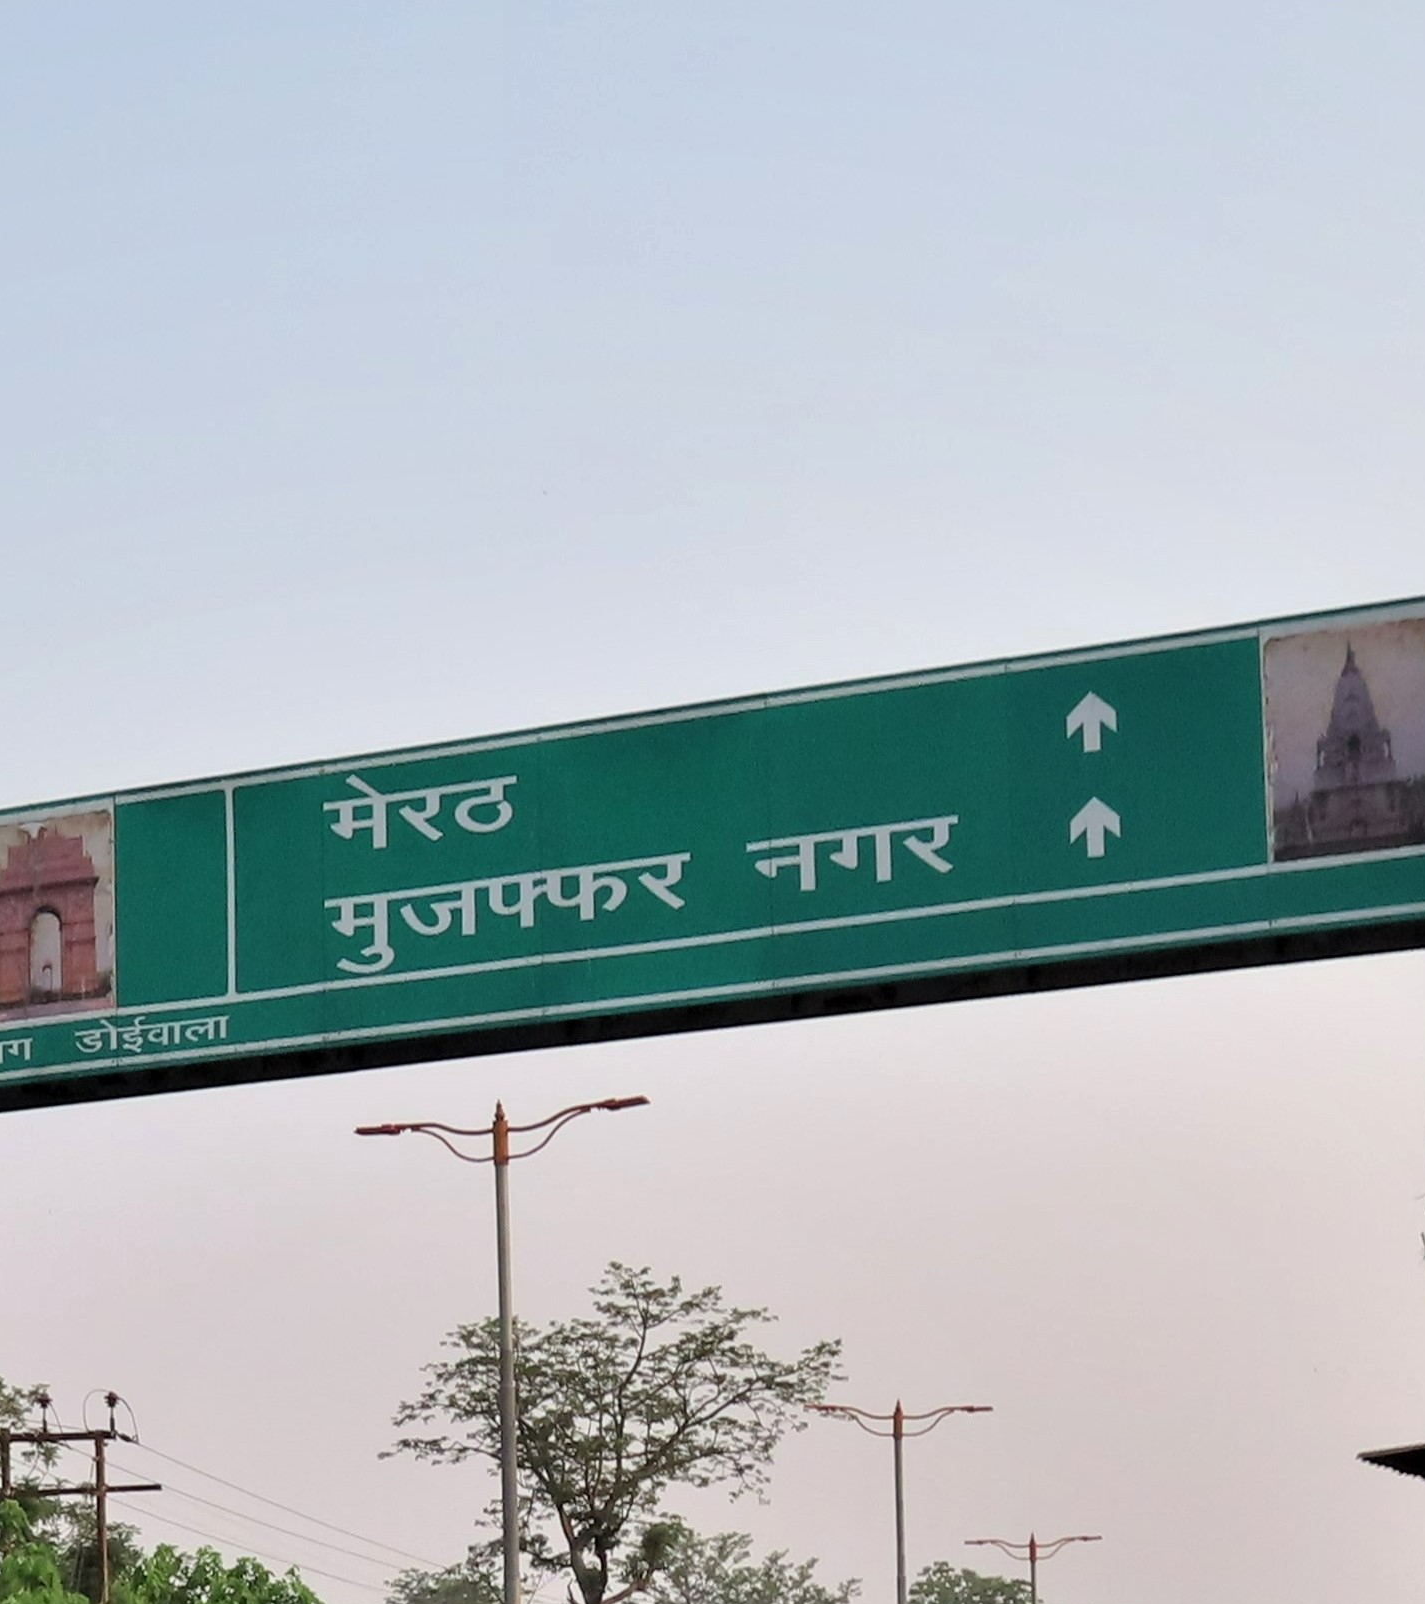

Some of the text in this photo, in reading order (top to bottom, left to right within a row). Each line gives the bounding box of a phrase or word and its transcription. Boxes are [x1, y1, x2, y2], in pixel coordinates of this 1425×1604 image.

[323, 774, 517, 849] मेरठ
[324, 815, 959, 974] मुजफ्फर नगर
[74, 1014, 230, 1054] डोईवाला
